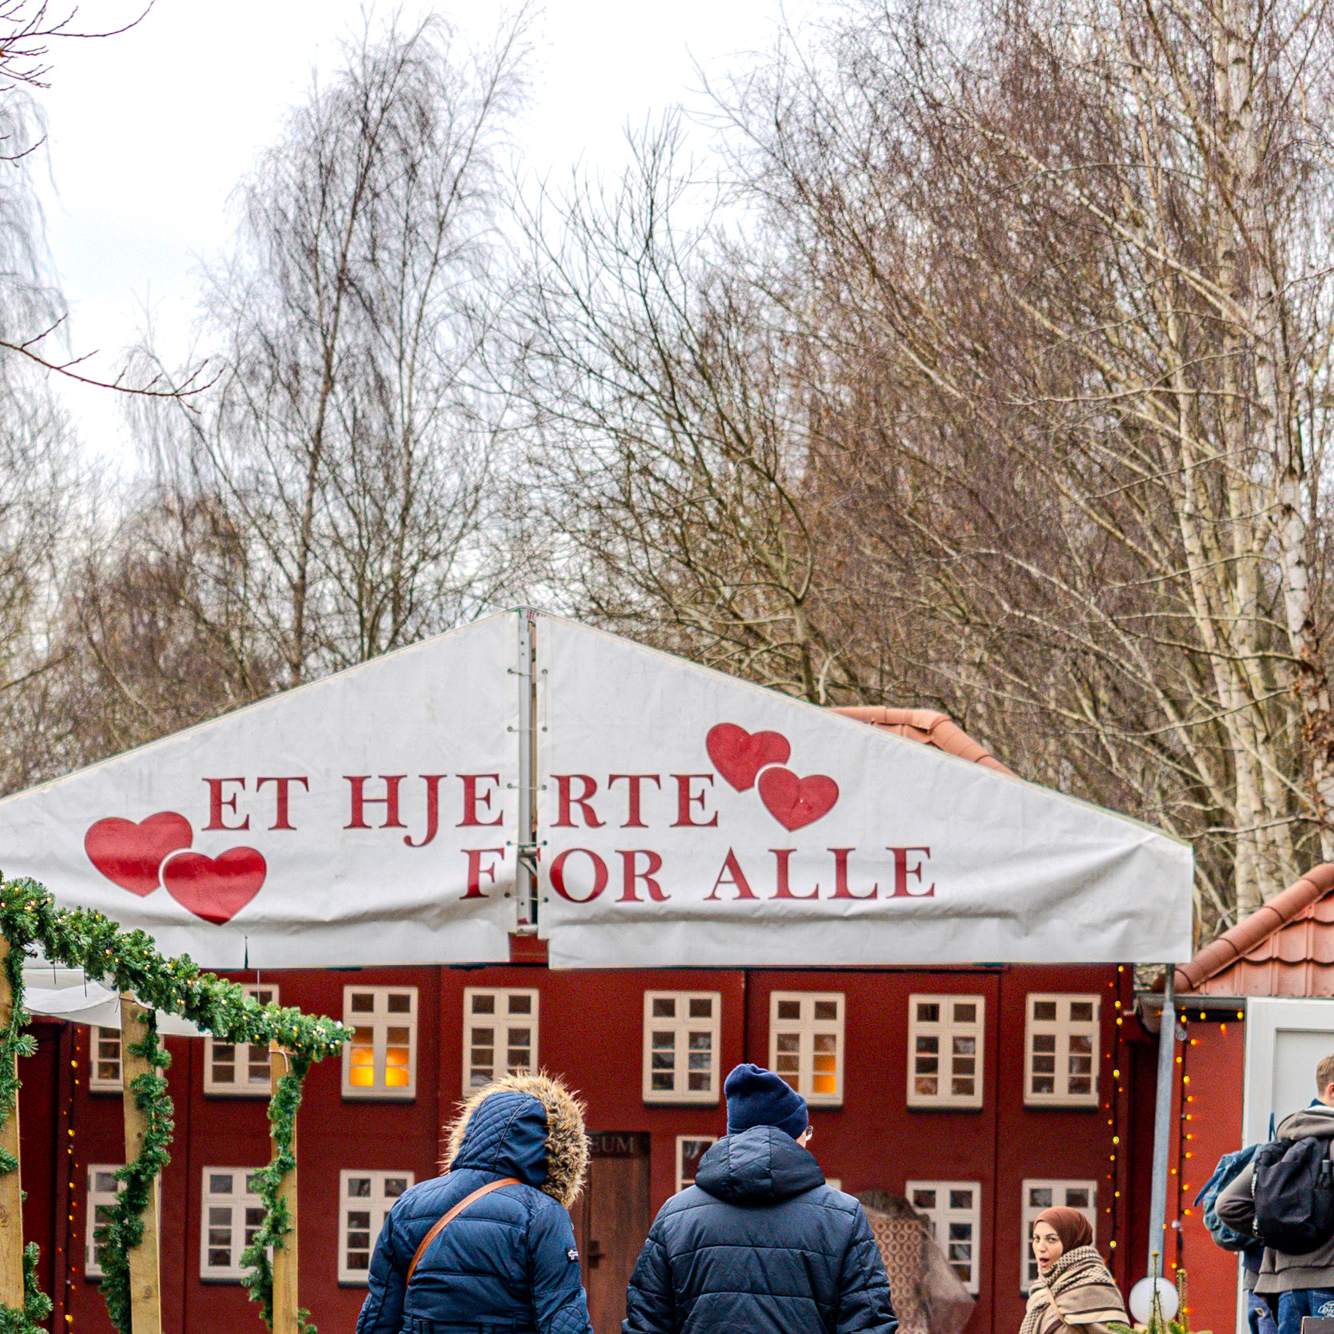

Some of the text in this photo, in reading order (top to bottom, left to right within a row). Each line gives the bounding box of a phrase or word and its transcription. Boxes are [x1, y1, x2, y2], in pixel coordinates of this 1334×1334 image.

[201, 776, 309, 832] ET
[459, 846, 935, 904] FOR ALLE
